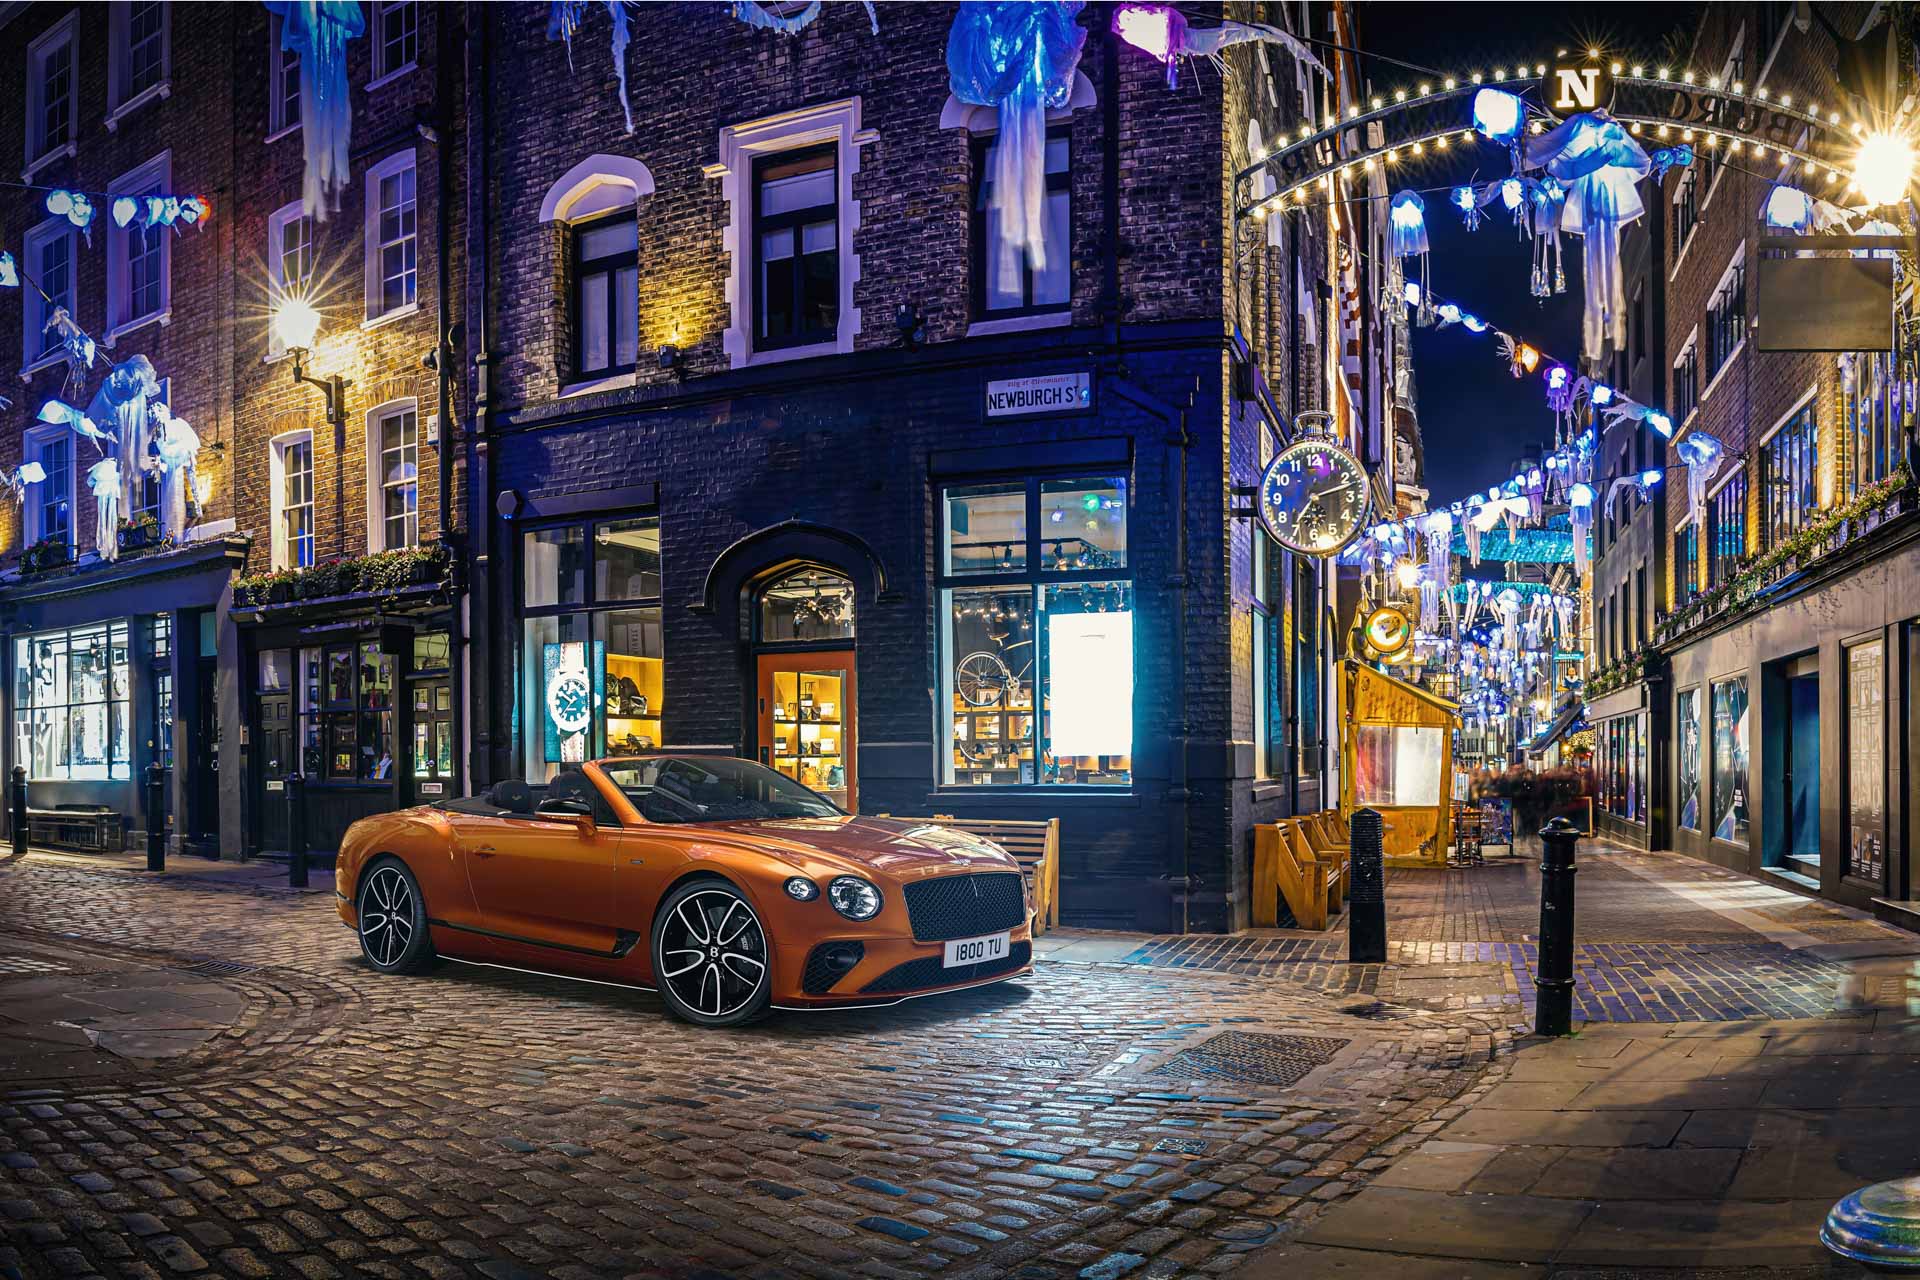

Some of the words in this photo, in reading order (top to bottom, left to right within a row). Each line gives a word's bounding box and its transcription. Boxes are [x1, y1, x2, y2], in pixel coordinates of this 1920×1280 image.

[1556, 69, 1600, 107] N
[988, 387, 1062, 410] NEWBURGH
[1290, 459, 1301, 472] 11
[1276, 474, 1290, 486] 10
[1273, 492, 1282, 505] 9
[1345, 490, 1355, 503] 3
[1278, 511, 1288, 523] 8
[1340, 509, 1351, 521] 4
[1309, 528, 1319, 541] 6
[955, 941, 984, 962] 1800
[988, 937, 1002, 956] TU
